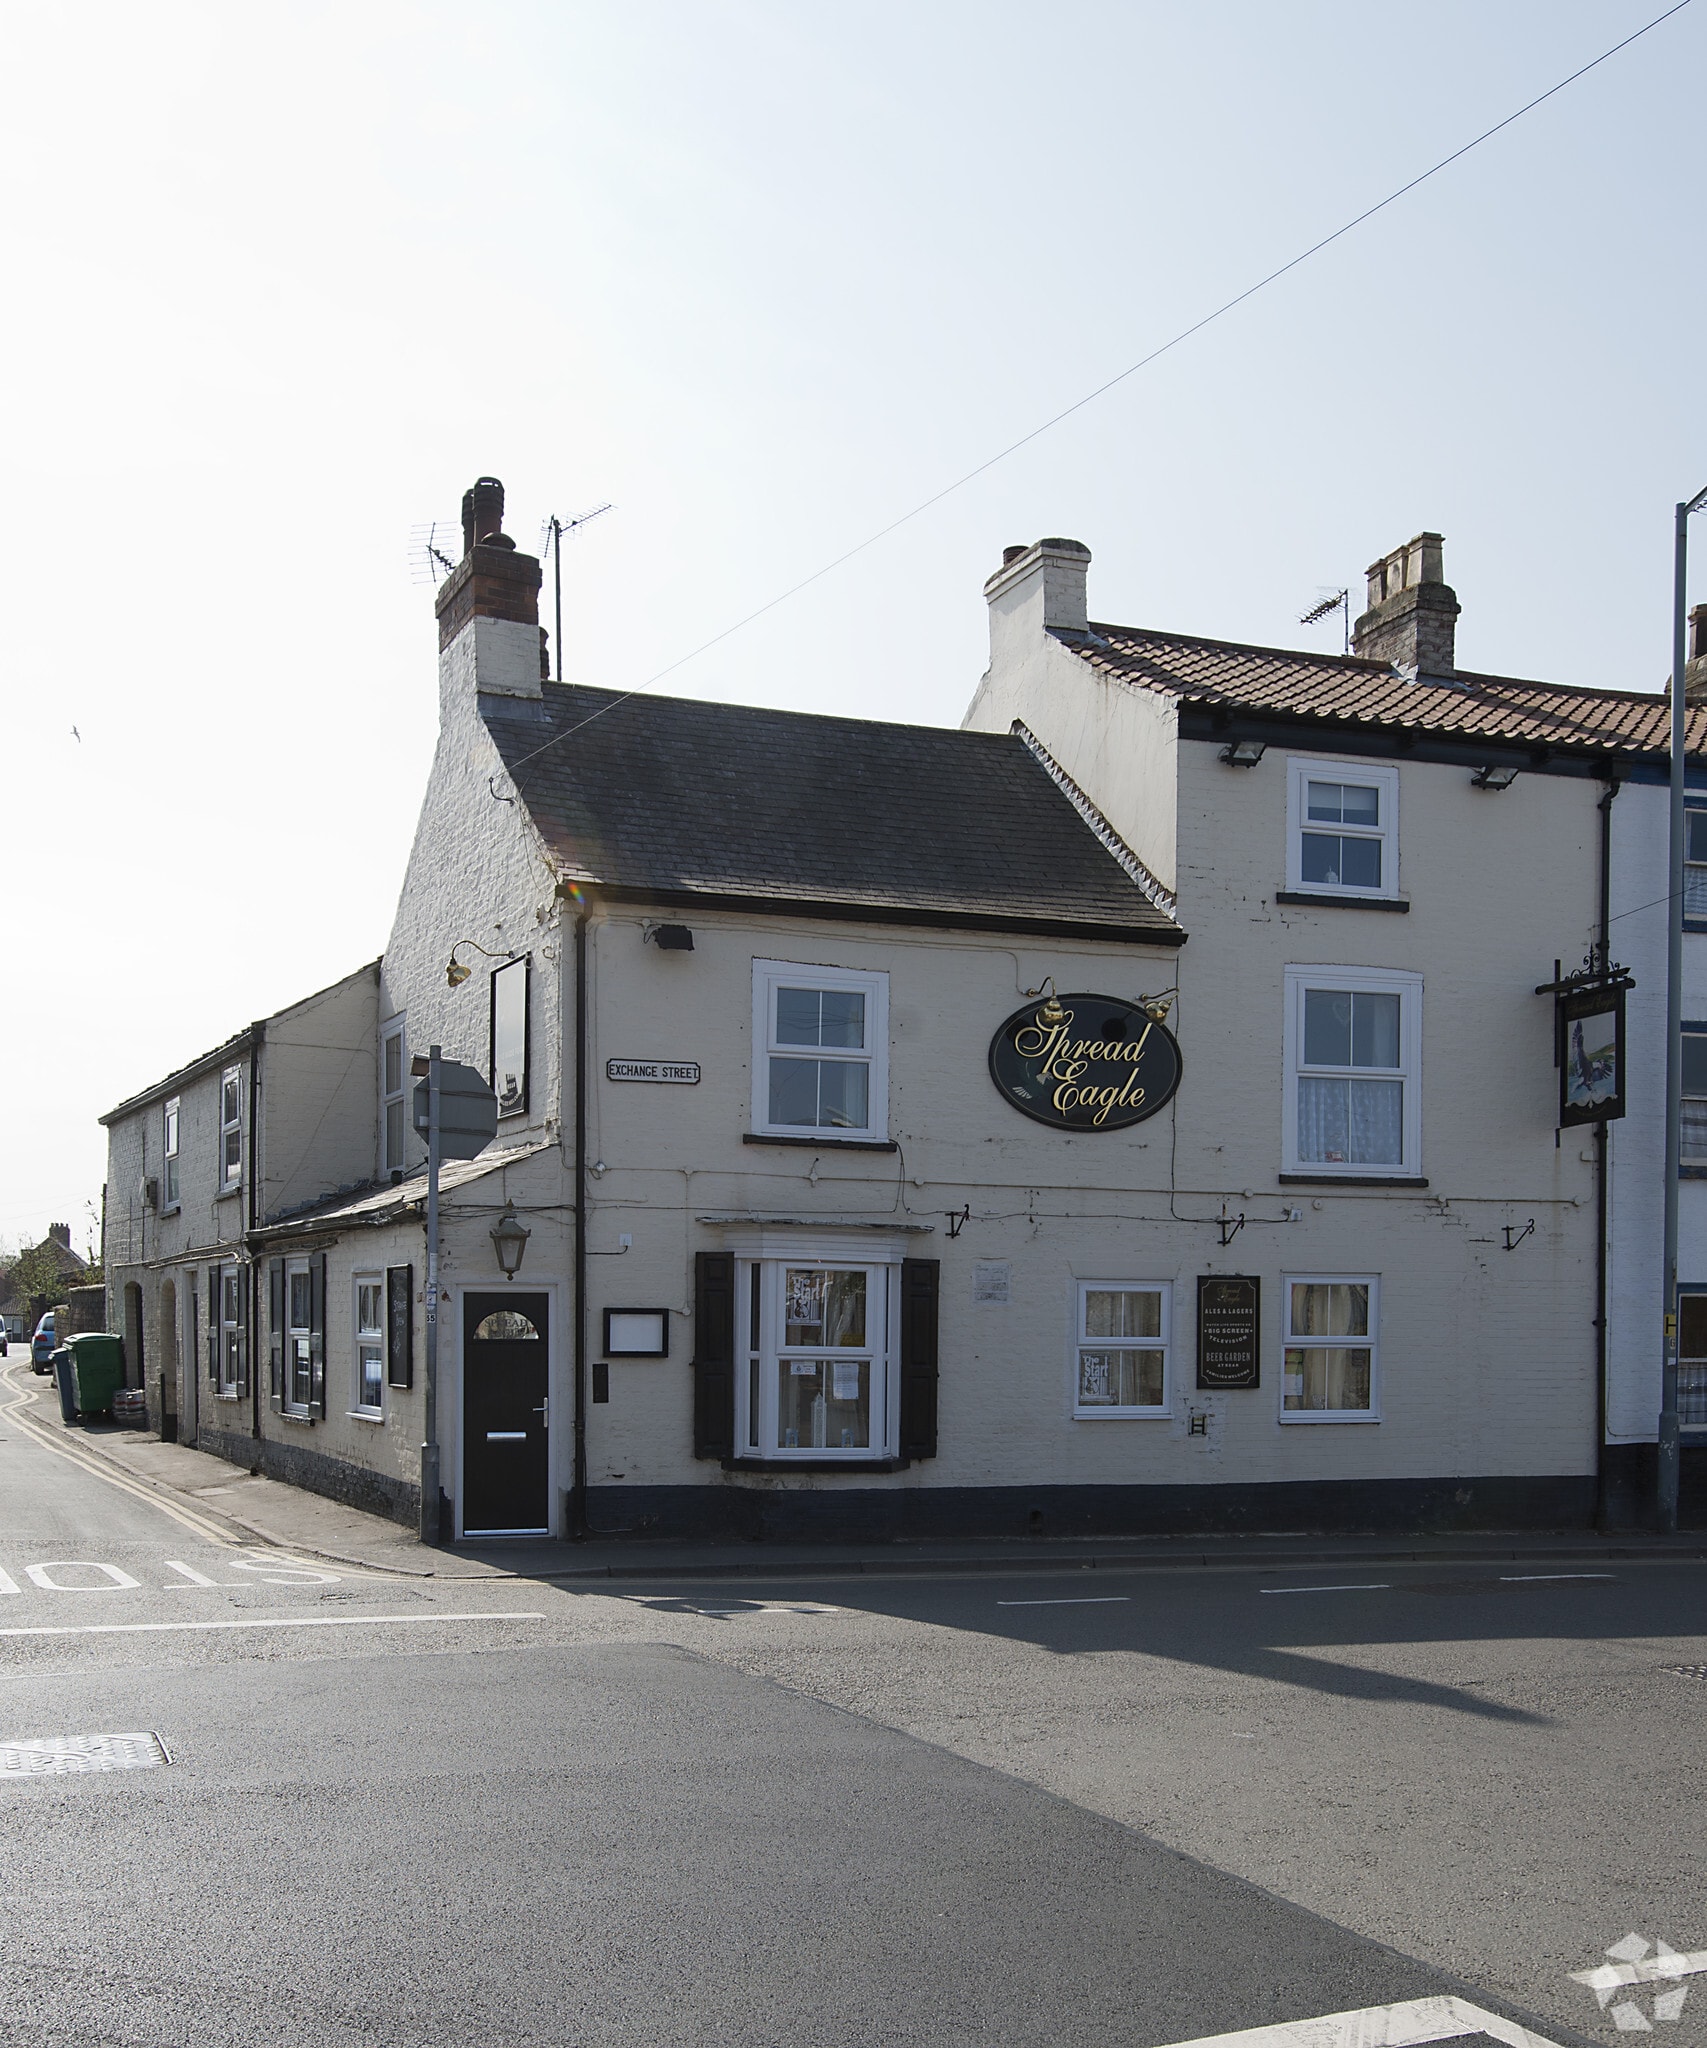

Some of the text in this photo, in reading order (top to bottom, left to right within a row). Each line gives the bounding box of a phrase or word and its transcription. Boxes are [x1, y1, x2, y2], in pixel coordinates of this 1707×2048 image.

[1015, 1010, 1153, 1074] Spread
[609, 1064, 699, 1079] EXCHANGE STREET
[1052, 1058, 1146, 1126] Eagle
[485, 1319, 528, 1328] SPEAD
[1209, 1335, 1247, 1344] TELEVISION
[1206, 1352, 1250, 1361] BEER GARDEN
[1085, 1356, 1109, 1377] Start
[1192, 1416, 1205, 1434] H
[0, 1559, 342, 1594] STO
